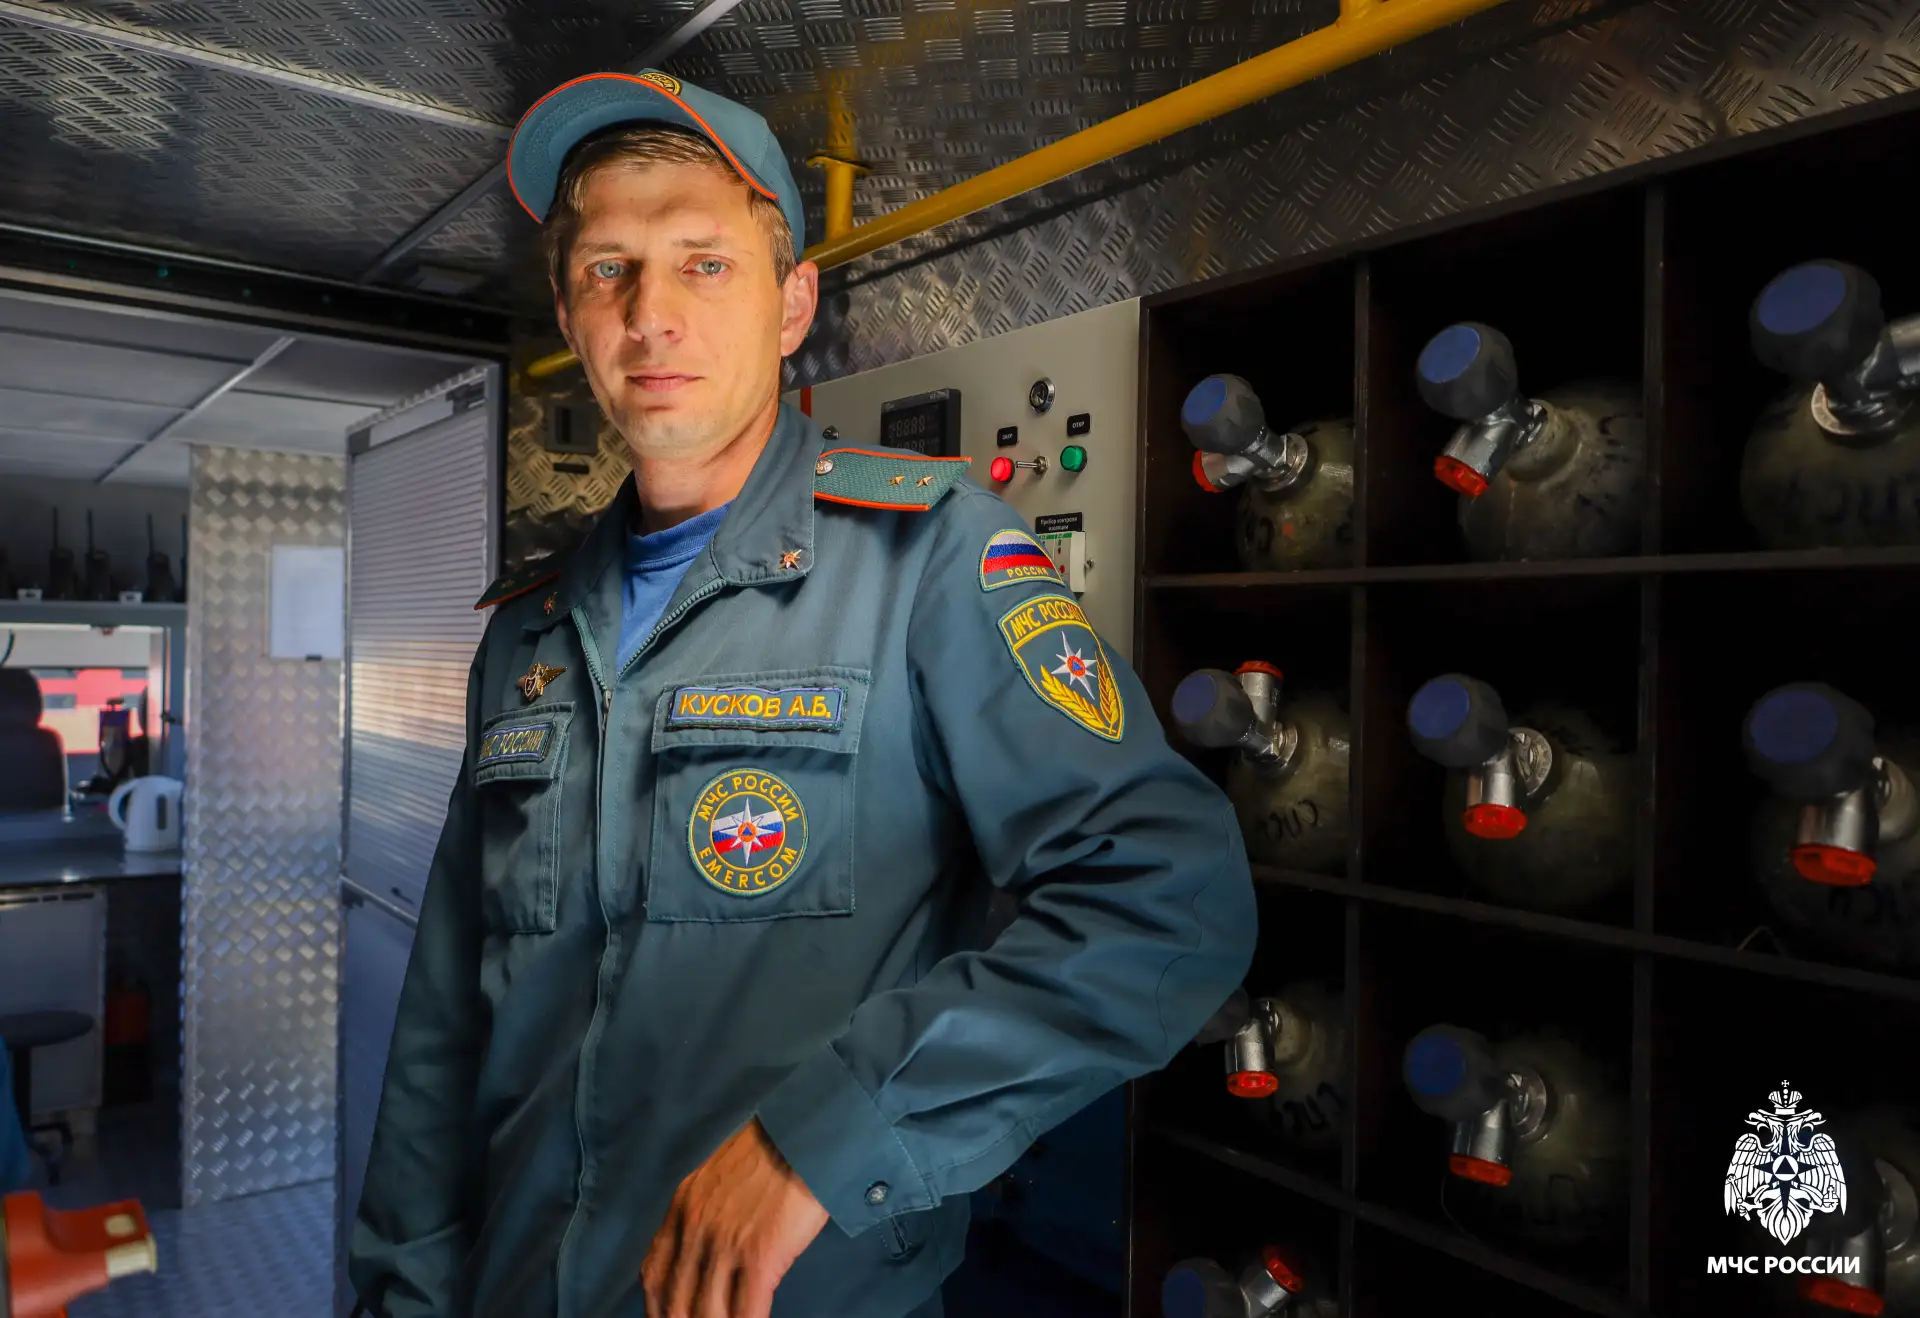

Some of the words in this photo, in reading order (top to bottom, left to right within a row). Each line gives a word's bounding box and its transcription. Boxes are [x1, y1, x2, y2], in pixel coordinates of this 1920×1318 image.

[1006, 566, 1049, 578] РОССИЯ
[1010, 607, 1042, 640] МЧС
[679, 693, 782, 718] КУСКОВ
[788, 694, 832, 718] А.Б.
[697, 783, 729, 822] МЧС
[732, 775, 800, 822] РОССИИ
[698, 845, 799, 889] EMERCOM
